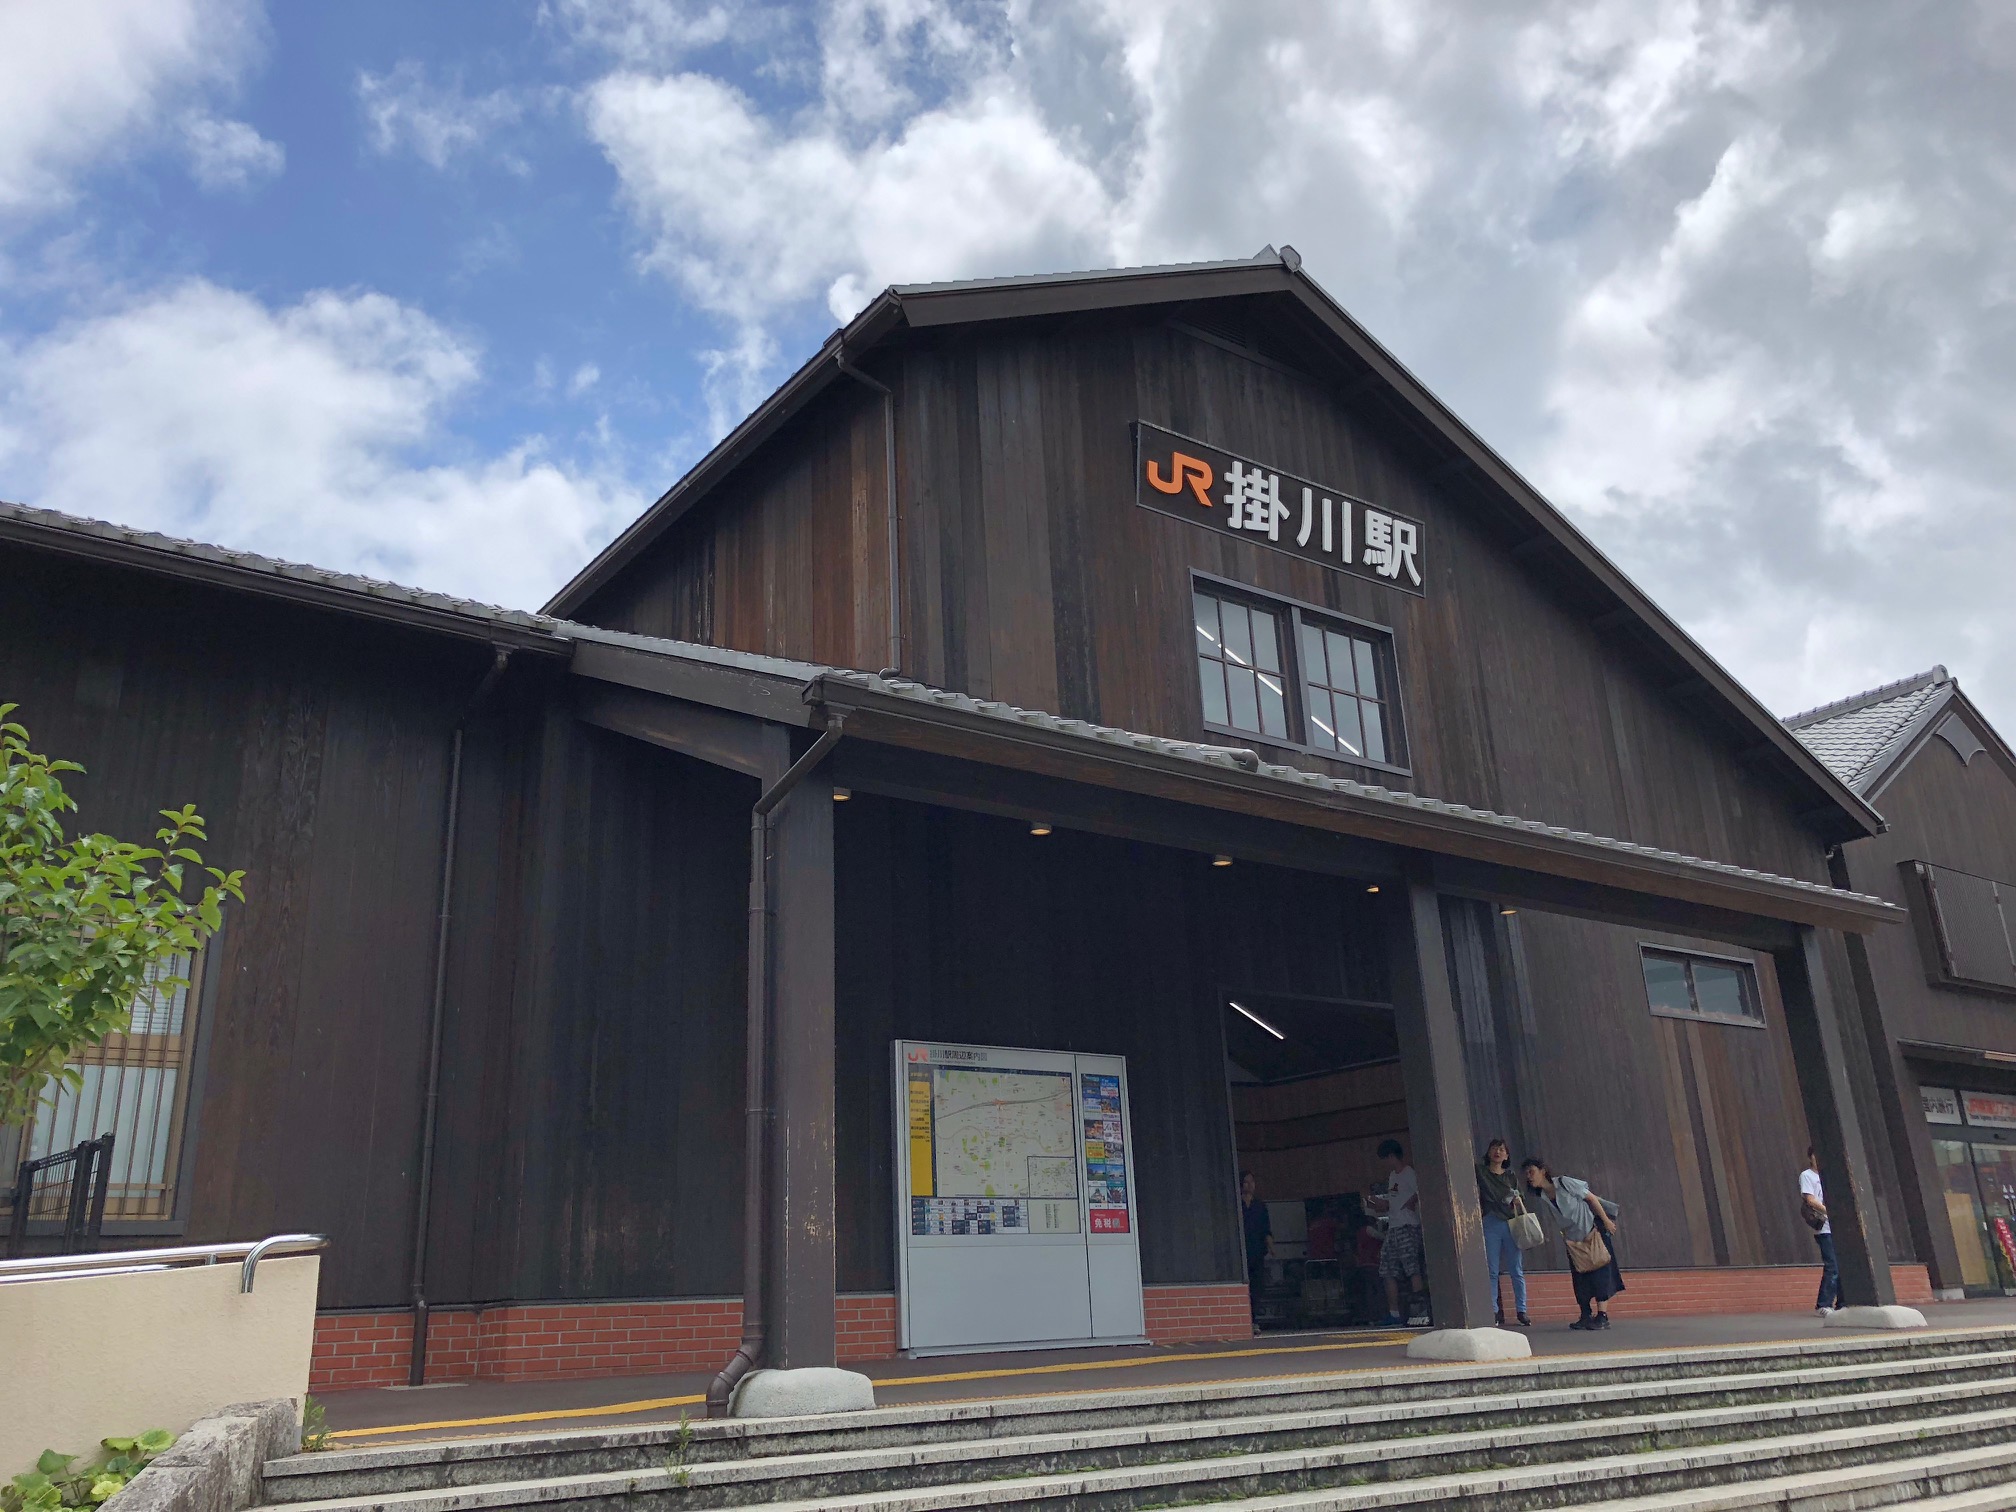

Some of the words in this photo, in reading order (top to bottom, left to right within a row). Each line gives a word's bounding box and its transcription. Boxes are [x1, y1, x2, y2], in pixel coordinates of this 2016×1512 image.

[1146, 451, 1213, 507] JR
[1223, 461, 1421, 587] 掛川駅
[907, 1047, 928, 1063] JR
[930, 1049, 988, 1062] 掛川駅周辺案内図
